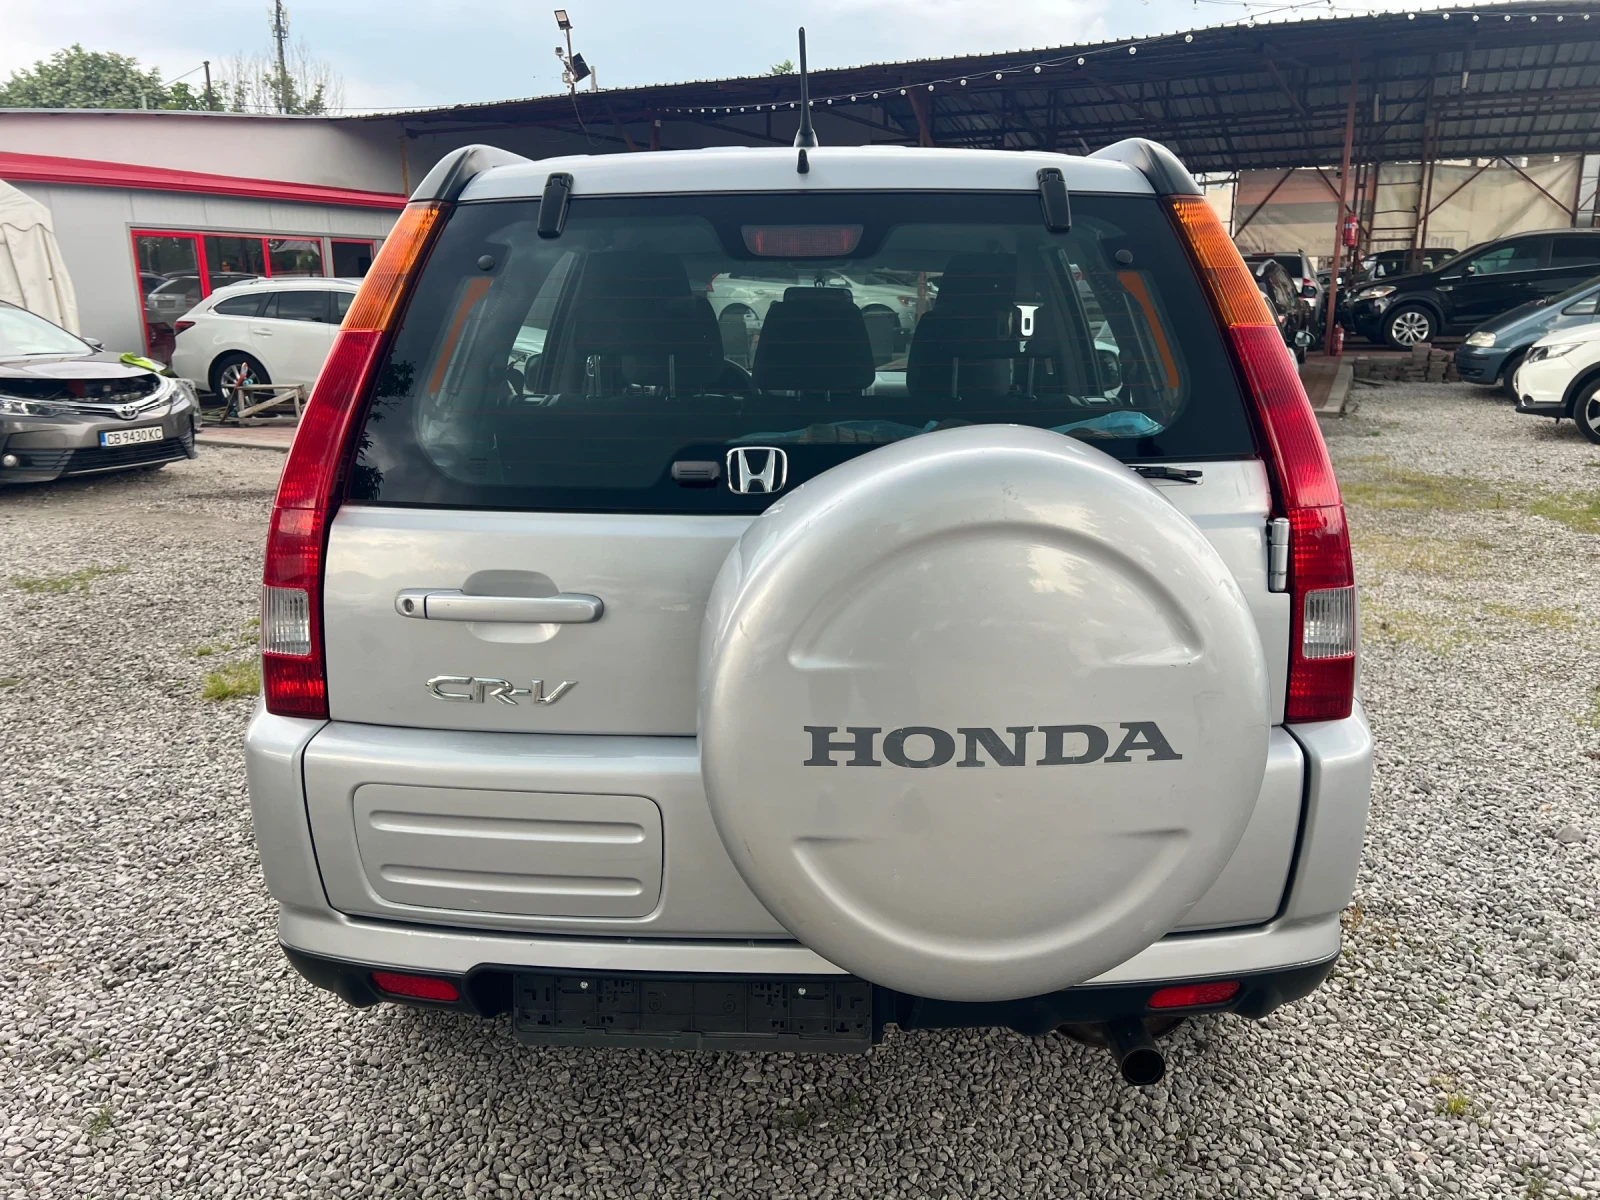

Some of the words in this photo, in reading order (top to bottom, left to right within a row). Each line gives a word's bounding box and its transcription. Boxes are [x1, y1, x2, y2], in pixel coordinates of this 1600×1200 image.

[107, 433, 121, 445] CB
[122, 430, 147, 443] 9430
[148, 428, 162, 440] KC
[425, 675, 579, 706] CR-V
[803, 721, 1183, 768] HONDA
